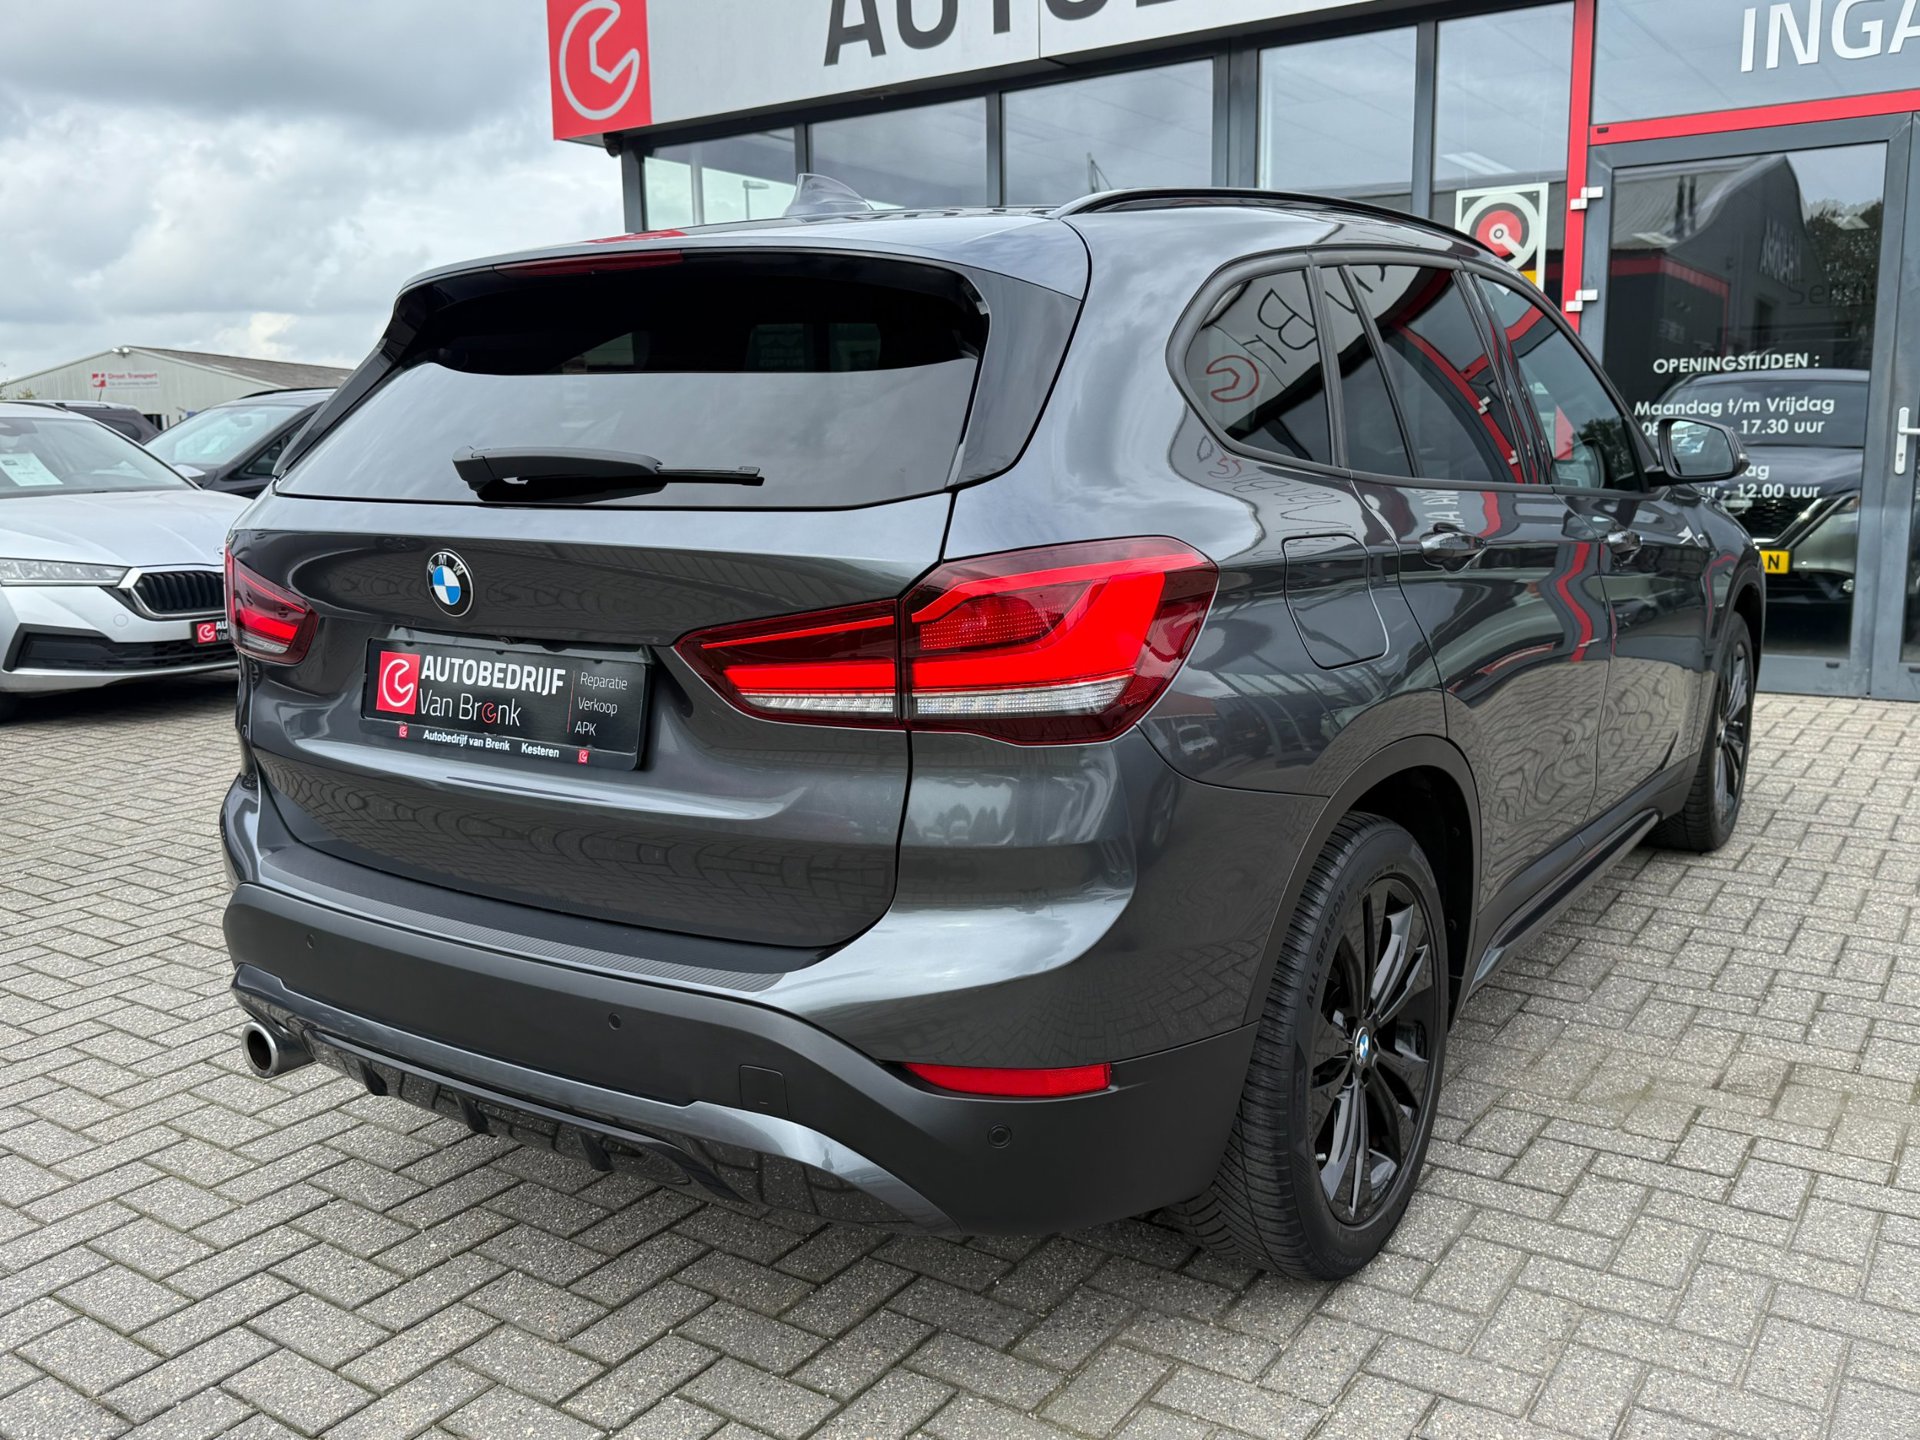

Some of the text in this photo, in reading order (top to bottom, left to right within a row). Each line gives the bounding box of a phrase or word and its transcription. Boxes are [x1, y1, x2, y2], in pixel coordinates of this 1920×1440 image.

[1653, 353, 1808, 373] OPENINGSTIJDEN
[1634, 396, 1835, 418] Maandag t/m Vrijdag
[1741, 418, 1789, 435] 17.30
[1794, 420, 1825, 434] uur
[1738, 483, 1785, 498] 12.00
[1790, 485, 1821, 498] uur
[428, 554, 465, 577] BMW
[420, 655, 566, 696] AUTOBEDRIJF
[580, 671, 628, 691] Reparatie
[420, 688, 521, 727] Van Brenk
[578, 696, 618, 717] Verkoop
[574, 720, 597, 736] APK
[423, 730, 560, 758] Autobedrijf van Brenk Kesteren
